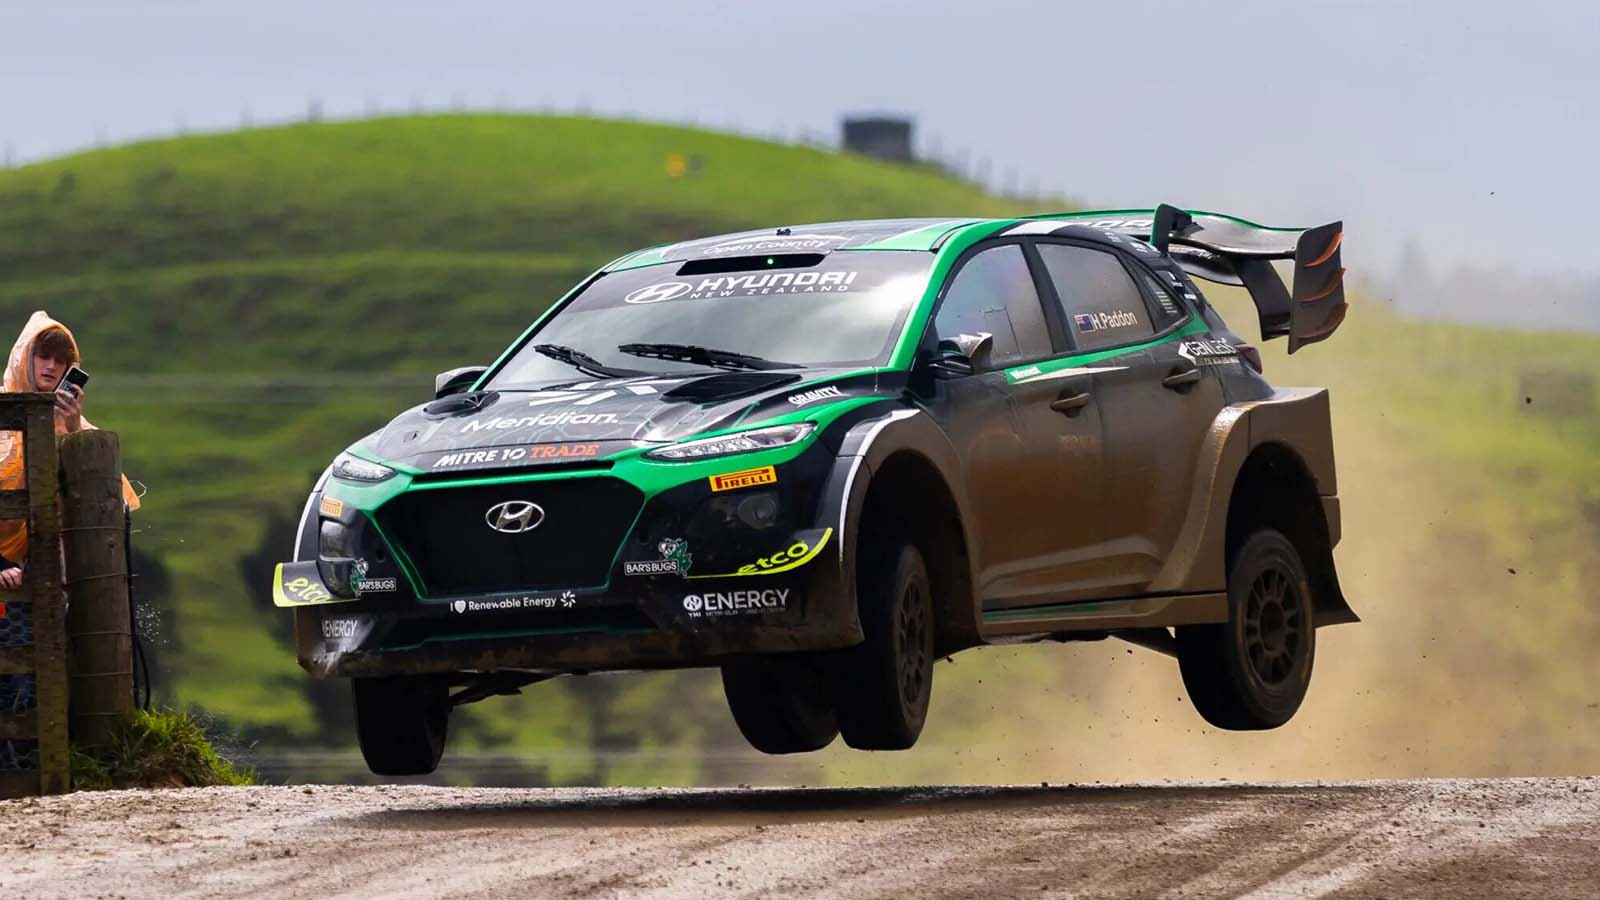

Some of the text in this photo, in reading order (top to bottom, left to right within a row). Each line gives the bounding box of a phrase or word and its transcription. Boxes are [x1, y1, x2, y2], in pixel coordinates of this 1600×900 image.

[696, 272, 856, 291] HYUNDAI
[690, 285, 849, 299] NEW ZEALAND
[1089, 309, 1138, 331] H.Paddon
[788, 386, 840, 405] GRAVITY
[433, 445, 599, 467] MITRE 10 TRADE
[714, 468, 771, 489] PIRELLI
[651, 561, 677, 571] BUGS
[374, 580, 395, 590] BUGS
[468, 598, 521, 611] Renewable
[523, 597, 557, 608] Energy
[703, 588, 789, 610] ENERGY
[325, 619, 358, 638] ENERGY
